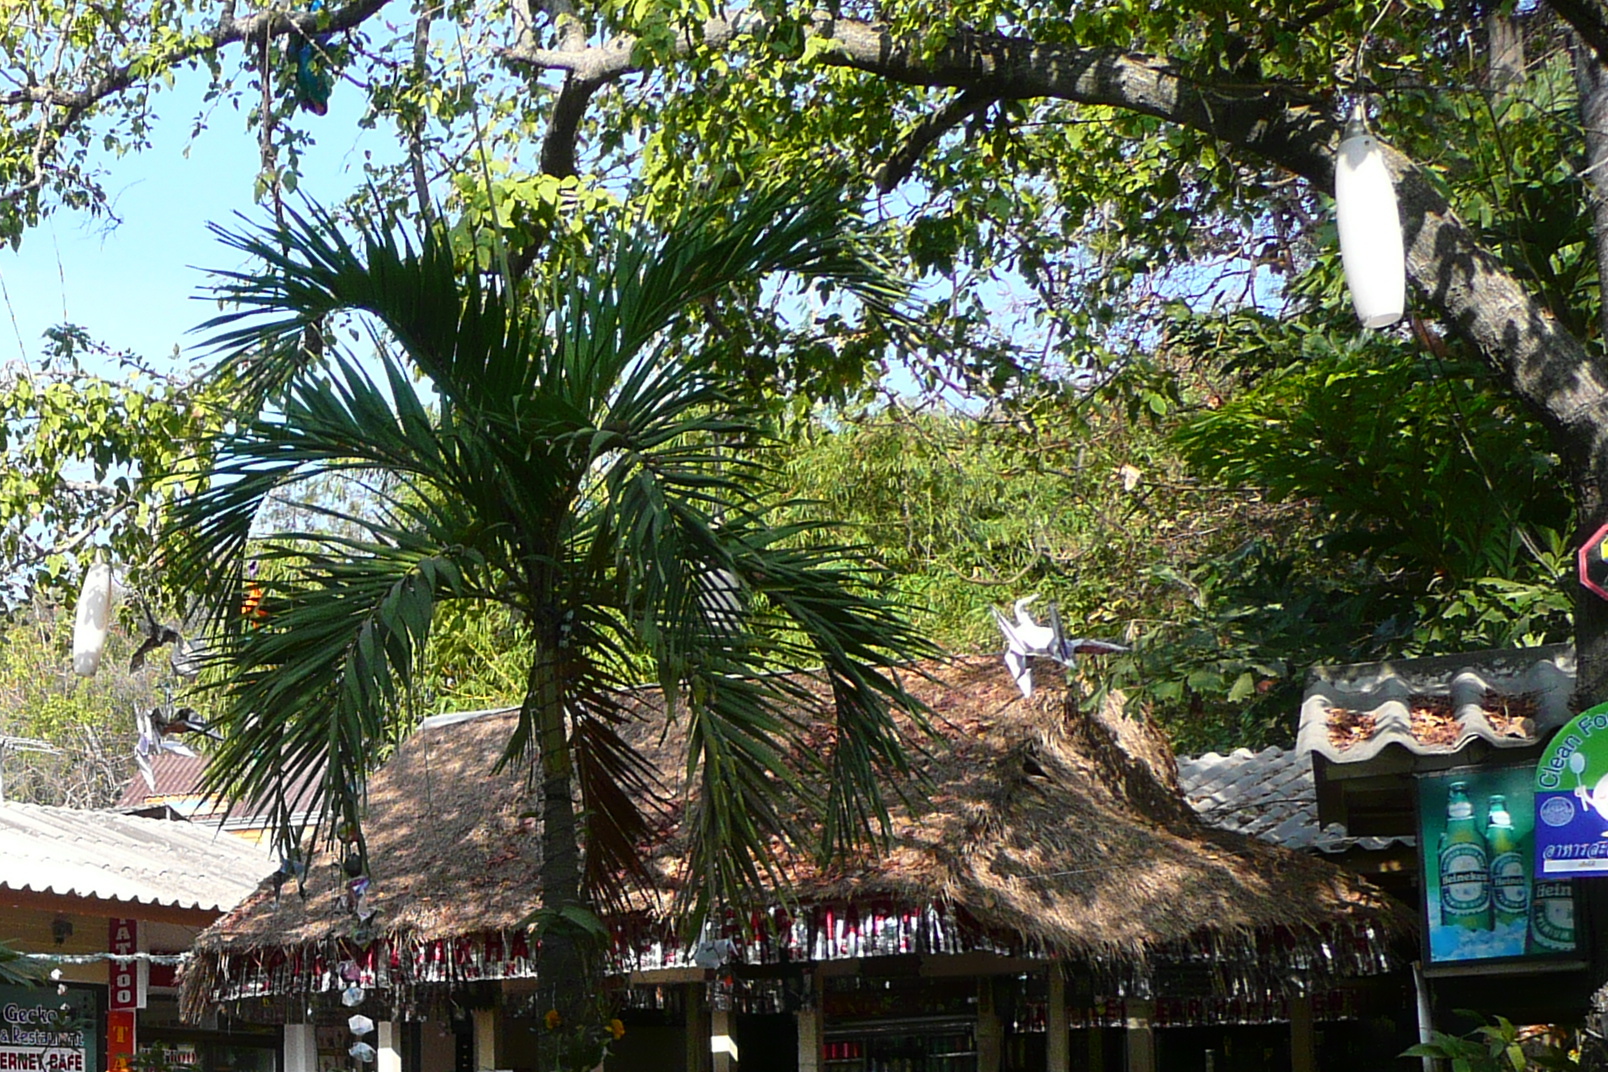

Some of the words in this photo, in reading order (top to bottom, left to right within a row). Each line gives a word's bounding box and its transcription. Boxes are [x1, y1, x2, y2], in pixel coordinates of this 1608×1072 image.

[1539, 732, 1582, 789] Clean
[1578, 713, 1608, 737] Fo
[1442, 872, 1489, 886] Heineken
[3, 1002, 59, 1024] Gecko
[0, 1028, 10, 1043] &
[50, 1053, 83, 1071] CAFE
